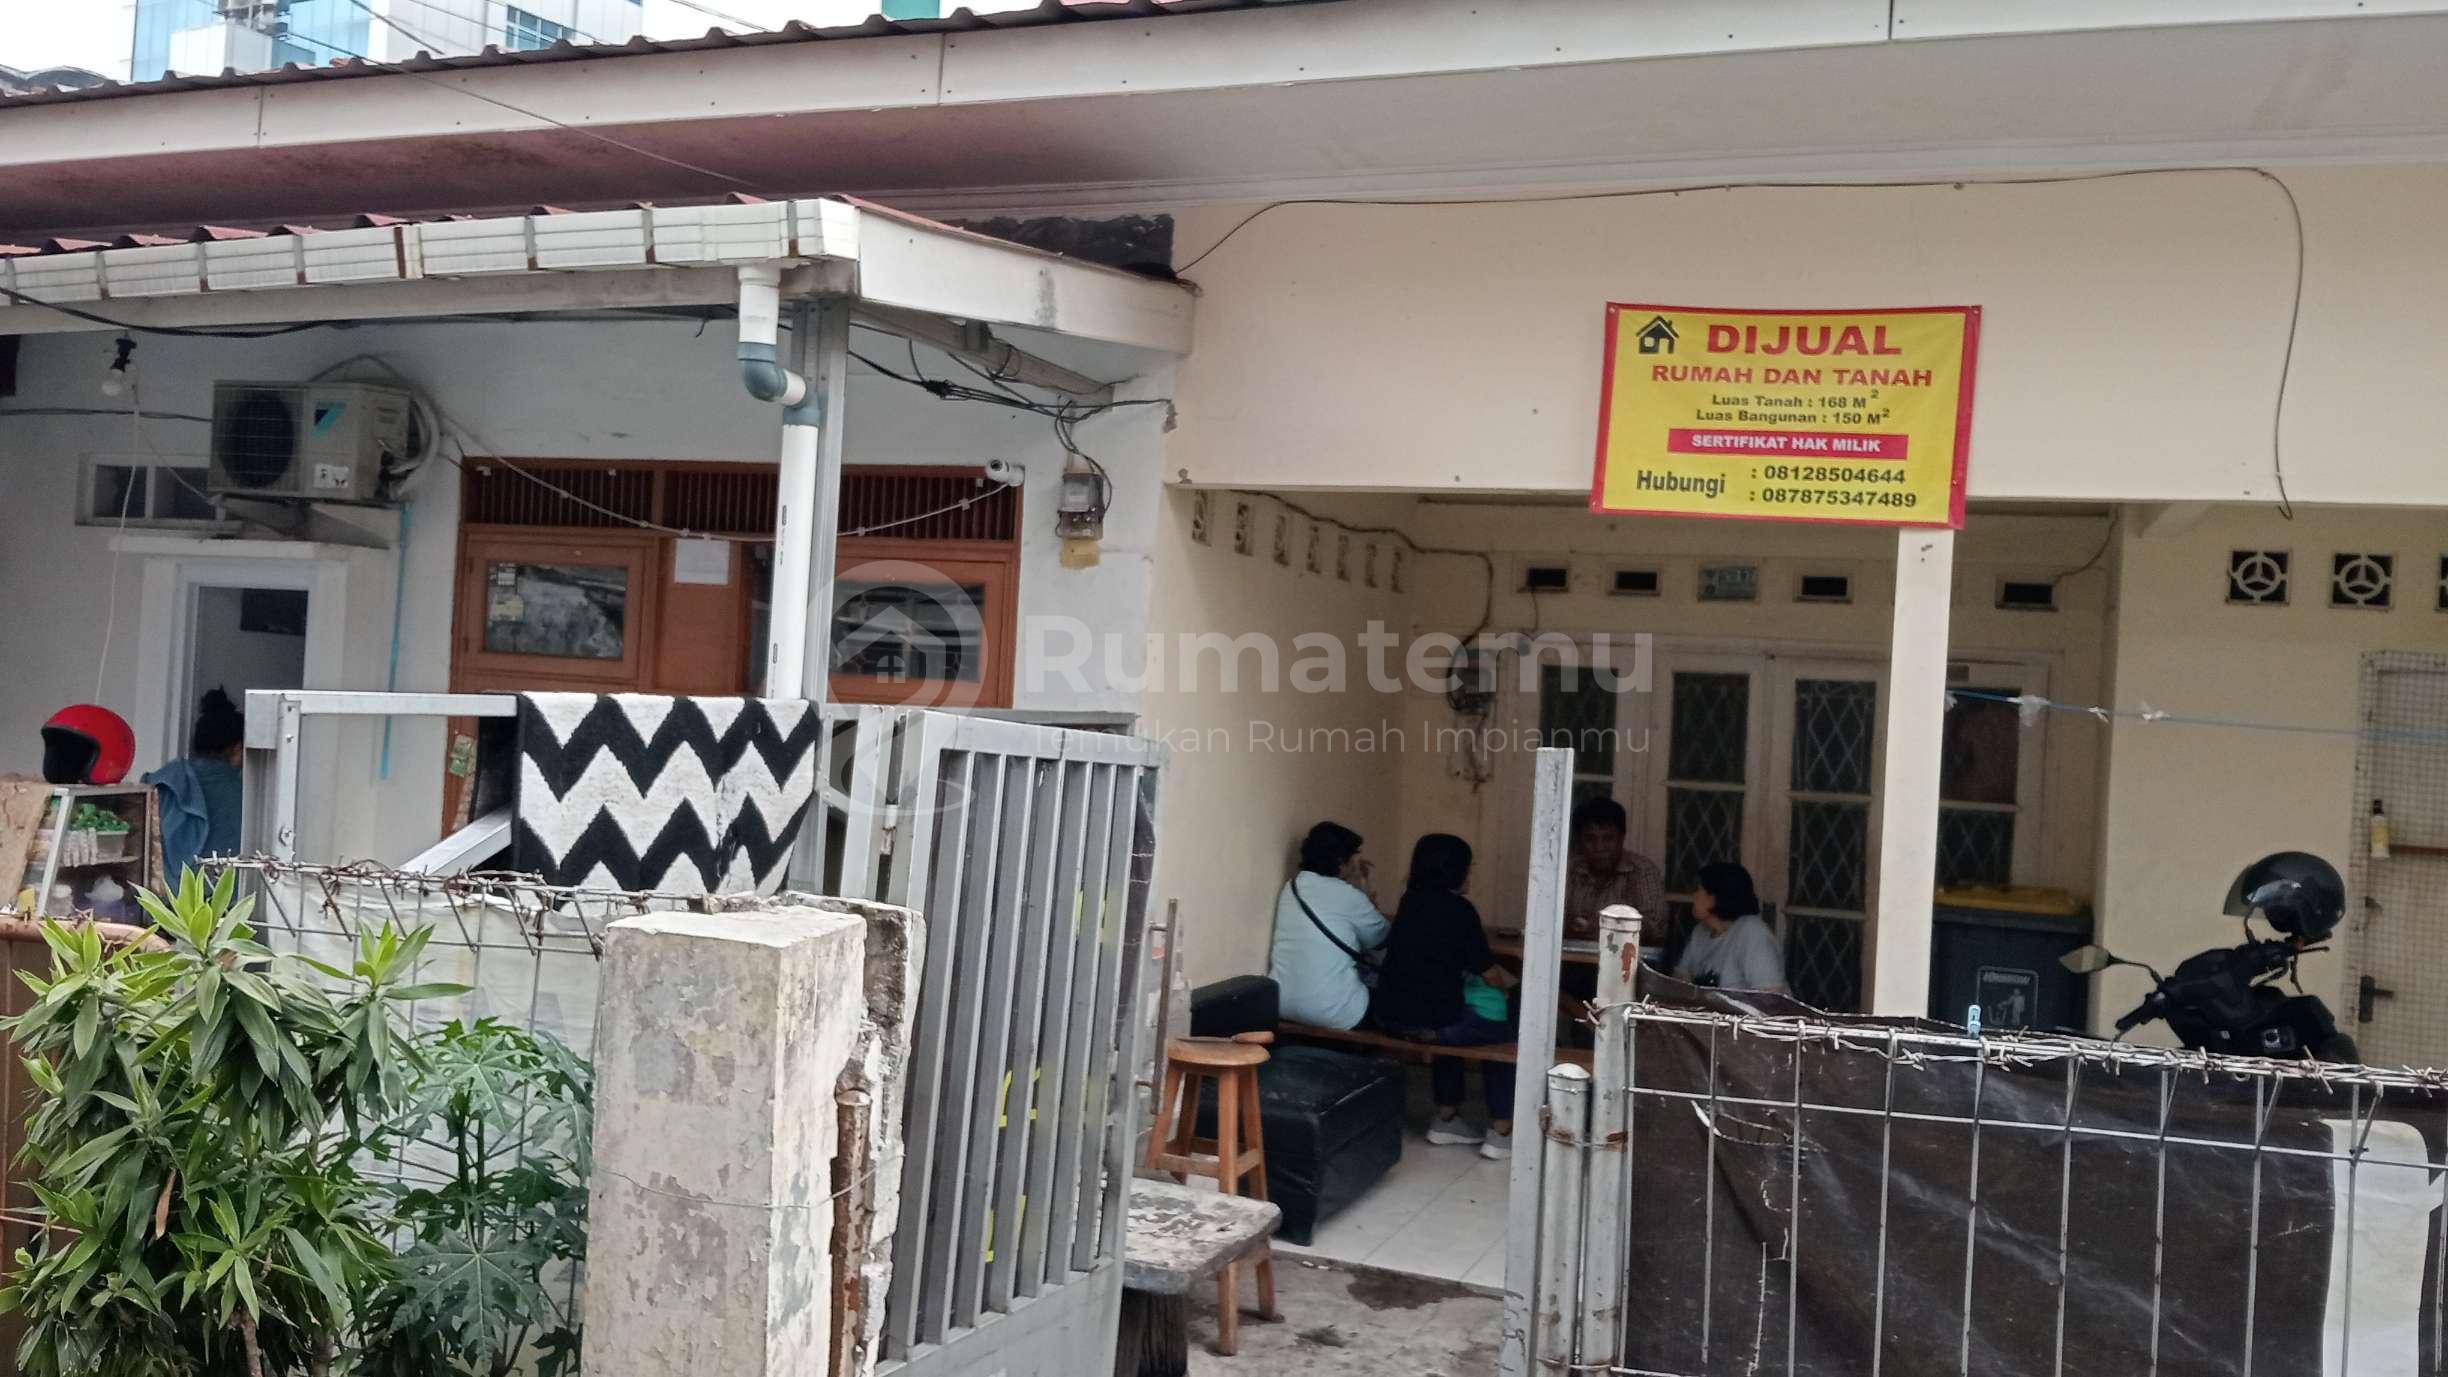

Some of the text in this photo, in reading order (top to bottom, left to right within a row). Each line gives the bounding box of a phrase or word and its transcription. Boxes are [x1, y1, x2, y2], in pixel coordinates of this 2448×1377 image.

[1706, 324, 1902, 356] DIJUAL
[1652, 365, 1932, 387] RUMAH DAN TANAH
[1712, 394, 1749, 406] Luas
[1754, 395, 1803, 408] Tanah
[1818, 397, 1847, 409] 168
[1696, 409, 1733, 421] Luas
[1738, 410, 1817, 425] Bangunan
[1832, 412, 1861, 424] 150
[1691, 434, 1881, 453] SERTIFIKAT HAK MILIK
[1636, 470, 1726, 499] Hubungi
[1763, 465, 1906, 484] 08128504644
[1761, 488, 1917, 507] 087875347489
